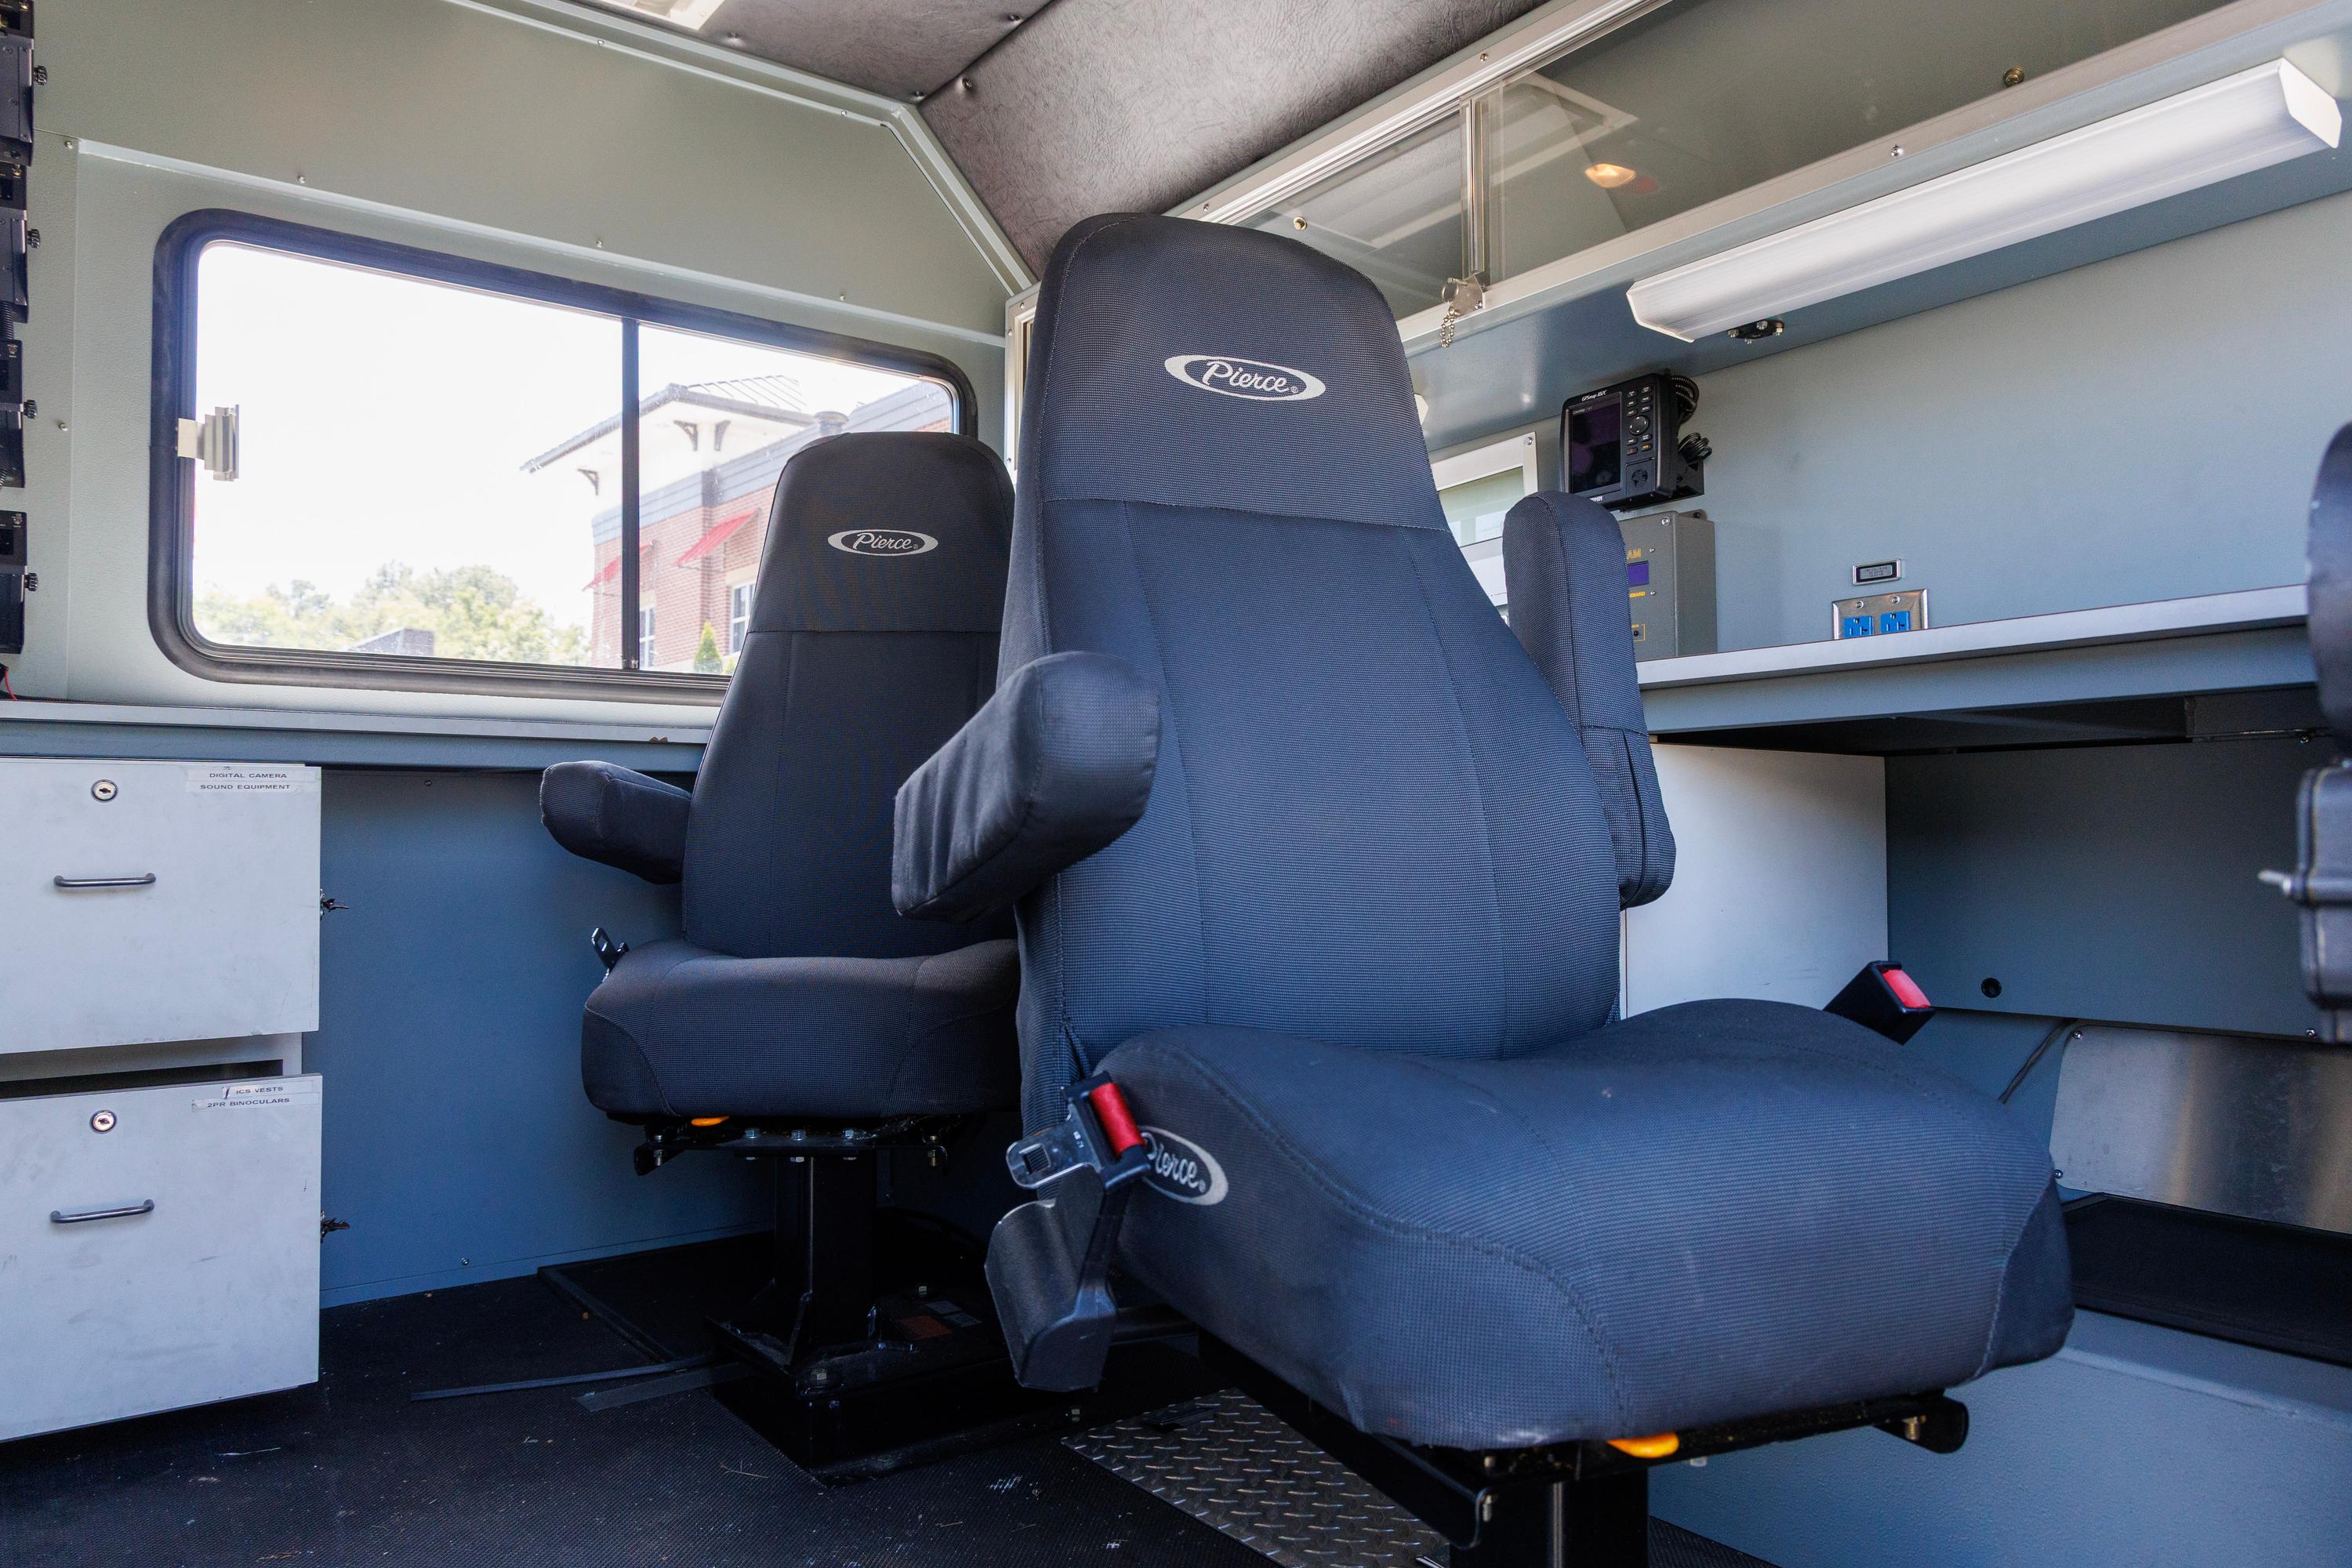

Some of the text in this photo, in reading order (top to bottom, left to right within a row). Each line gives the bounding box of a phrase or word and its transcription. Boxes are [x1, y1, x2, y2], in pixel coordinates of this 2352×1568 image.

[1202, 360, 1290, 393] Pierce
[852, 532, 913, 550] Pierce
[230, 1098, 290, 1106] BINOCULARS
